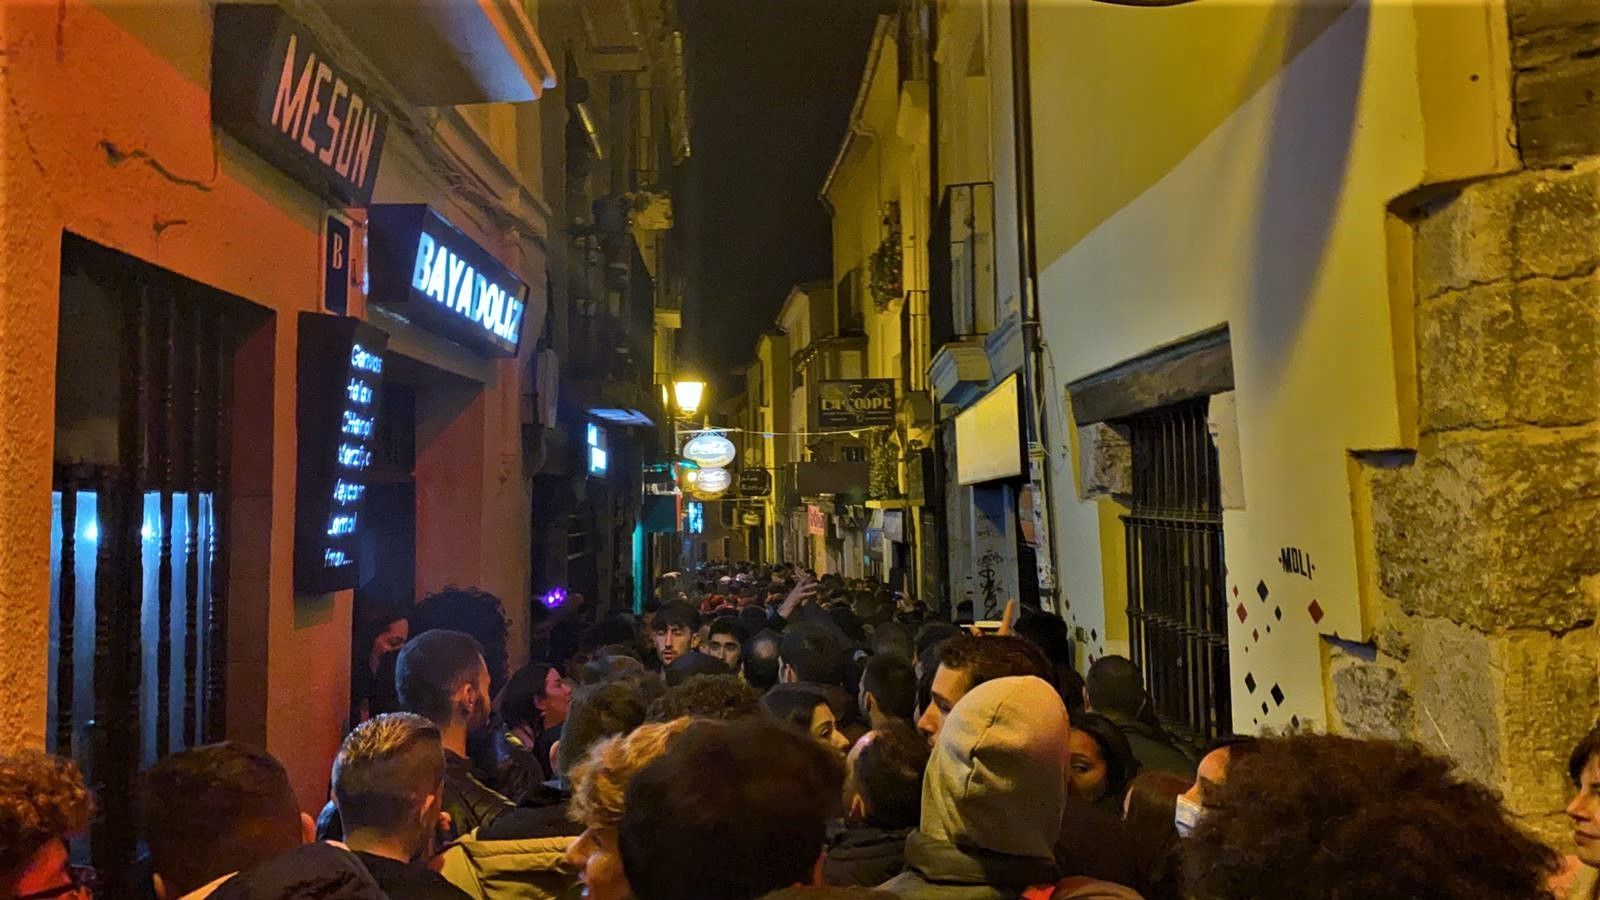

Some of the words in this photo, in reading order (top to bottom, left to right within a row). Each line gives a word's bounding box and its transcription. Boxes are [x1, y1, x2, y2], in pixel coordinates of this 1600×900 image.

[272, 34, 377, 188] MESON
[332, 231, 343, 270] B
[412, 232, 523, 343] BAYADOLIZ
